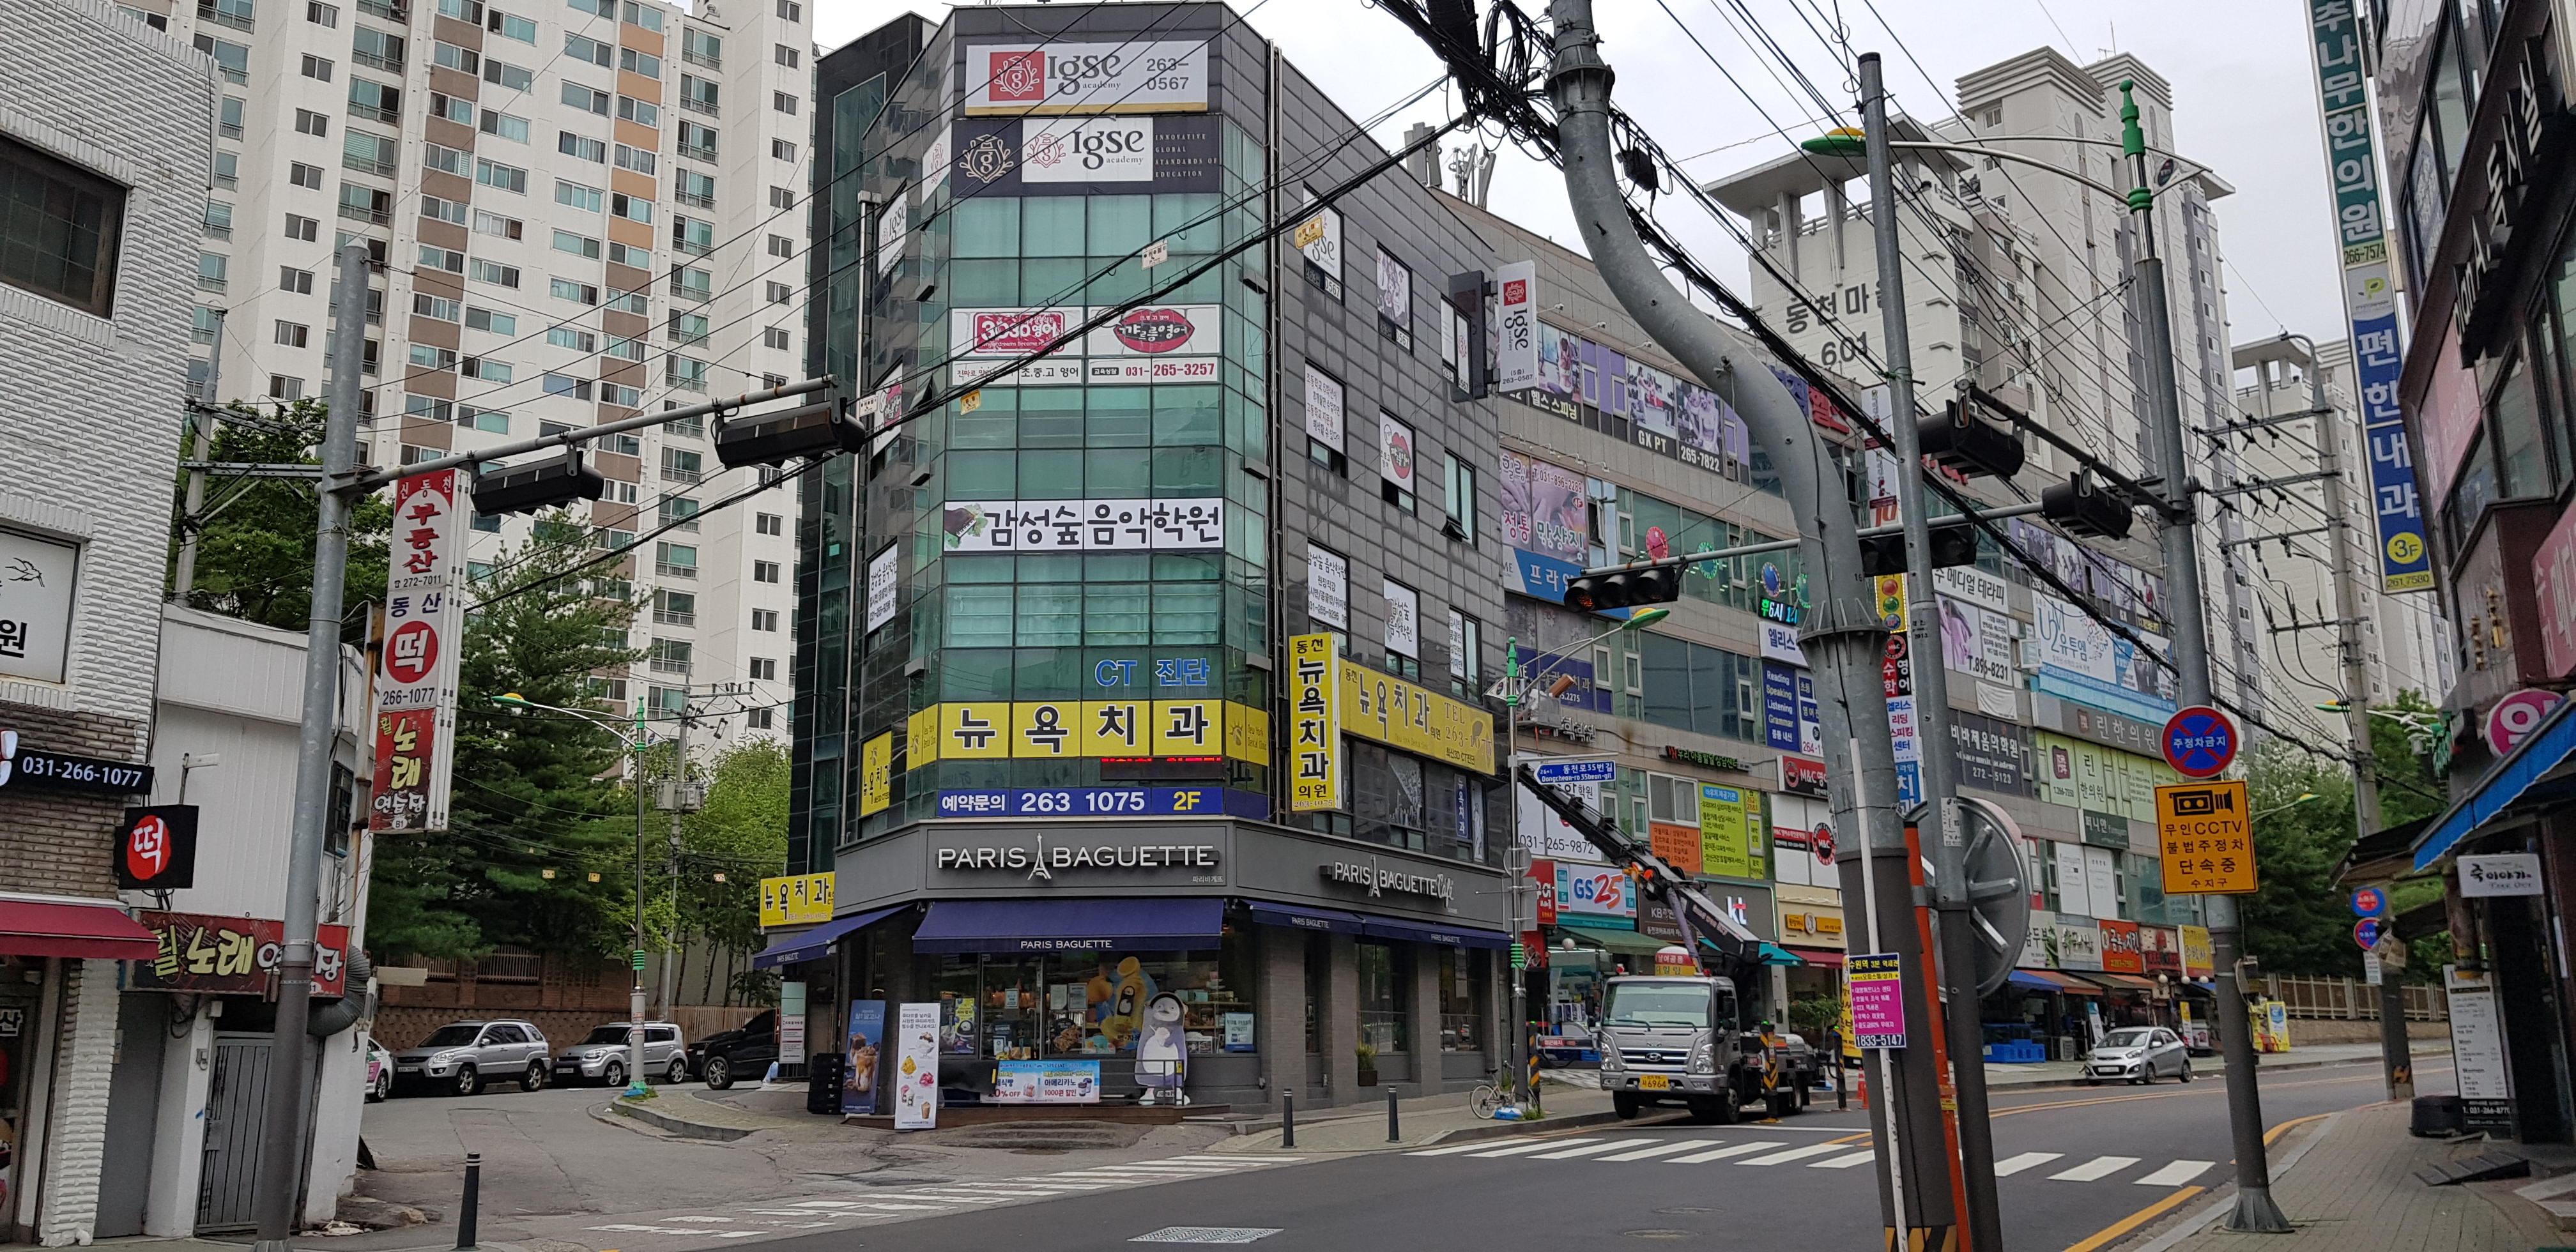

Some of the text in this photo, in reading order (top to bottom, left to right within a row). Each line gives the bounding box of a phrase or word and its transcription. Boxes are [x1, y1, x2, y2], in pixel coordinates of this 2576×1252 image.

[1047, 54, 1122, 95] Igse
[1082, 80, 1121, 91] academy
[1146, 77, 1189, 91] 0567
[1155, 133, 1206, 141] INNOVATIVE
[1072, 130, 1145, 170] Igse
[1106, 155, 1144, 165] academy
[1155, 157, 1203, 166] STANDARDS
[1060, 367, 1078, 378] 영어
[1637, 429, 1666, 454] GX PT
[1504, 510, 1530, 543] 정통
[404, 503, 442, 577] 부동산
[2394, 539, 2418, 558] 3F
[403, 574, 442, 588] 272-7011
[1977, 578, 2005, 606] 테라피
[394, 632, 426, 675] 떡
[1296, 639, 1324, 654] 동천
[1095, 657, 1211, 687] CT 진단
[1767, 671, 1790, 685] Reading
[1897, 659, 1911, 692] 영어
[383, 687, 435, 706] 266-1077
[1766, 685, 1792, 701] Speaking
[1345, 668, 1357, 683] 동천
[1359, 671, 1430, 742] 뉴욕치과
[1445, 702, 1465, 724] TEL
[1767, 699, 1793, 715] Listening
[1298, 656, 1330, 782] 뉴욕치과
[1768, 714, 1793, 728] Grammar
[1892, 713, 1908, 724] 리딩
[953, 703, 1211, 755] 뉴욕치과
[2096, 715, 2156, 752] 린한의원
[1894, 740, 1911, 751] 센터
[2174, 735, 2227, 749] 주정차금지
[22, 755, 142, 789] 031-266-1077
[2083, 754, 2096, 777] 린
[1542, 774, 1581, 783] Dongcheon-ro
[1800, 768, 1817, 784] M&C
[1299, 784, 1327, 798] 의원
[2080, 781, 2104, 803] 한의원
[373, 793, 426, 814] 연습장
[942, 790, 1201, 813] 예약문의 263 1075 2F
[395, 820, 404, 828] B1
[2165, 820, 2243, 836] 무인CCTV
[132, 816, 164, 875] 떡
[2166, 838, 2244, 855] 불법주정차
[938, 845, 1215, 869] PARIS BAGUETTE
[2180, 857, 2236, 875] 단속중
[1332, 860, 1370, 886] PARIS
[1380, 869, 1437, 897] BAGUETTE
[2191, 878, 2228, 889] 수지구
[765, 877, 830, 921] 뉴욕치과
[1574, 873, 1624, 910] GS25
[1292, 917, 1330, 929] PARIS BAGUETTE
[1021, 940, 1112, 949] PARIS BAGUETTE
[1431, 933, 1442, 942] PARIS
[188, 925, 256, 977] 노래
[1856, 1034, 1902, 1047] 1833-5147
